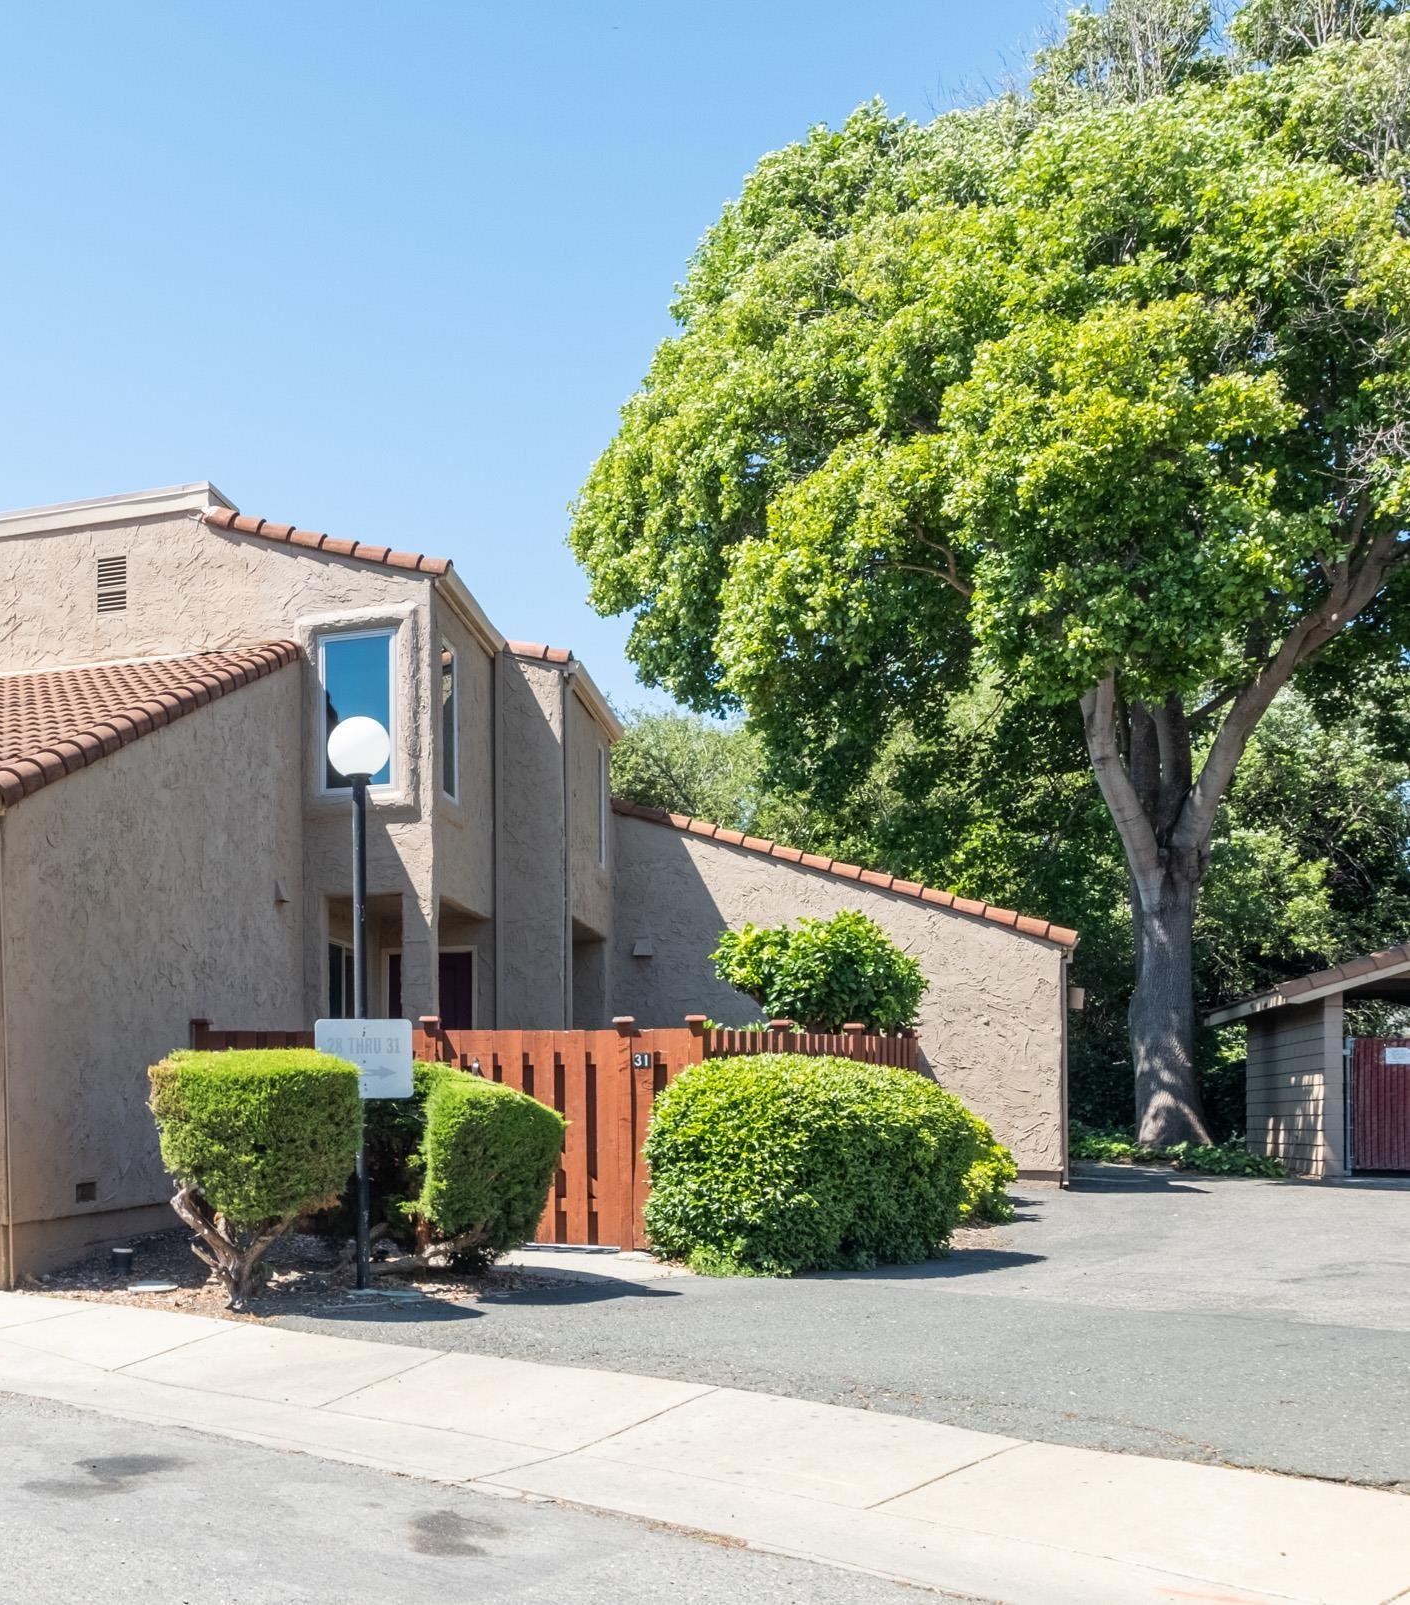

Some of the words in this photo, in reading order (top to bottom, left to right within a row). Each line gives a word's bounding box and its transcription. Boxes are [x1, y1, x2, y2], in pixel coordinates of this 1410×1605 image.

[348, 1037, 381, 1054] THRU
[386, 1037, 401, 1054] 31
[634, 1054, 648, 1067] 31
